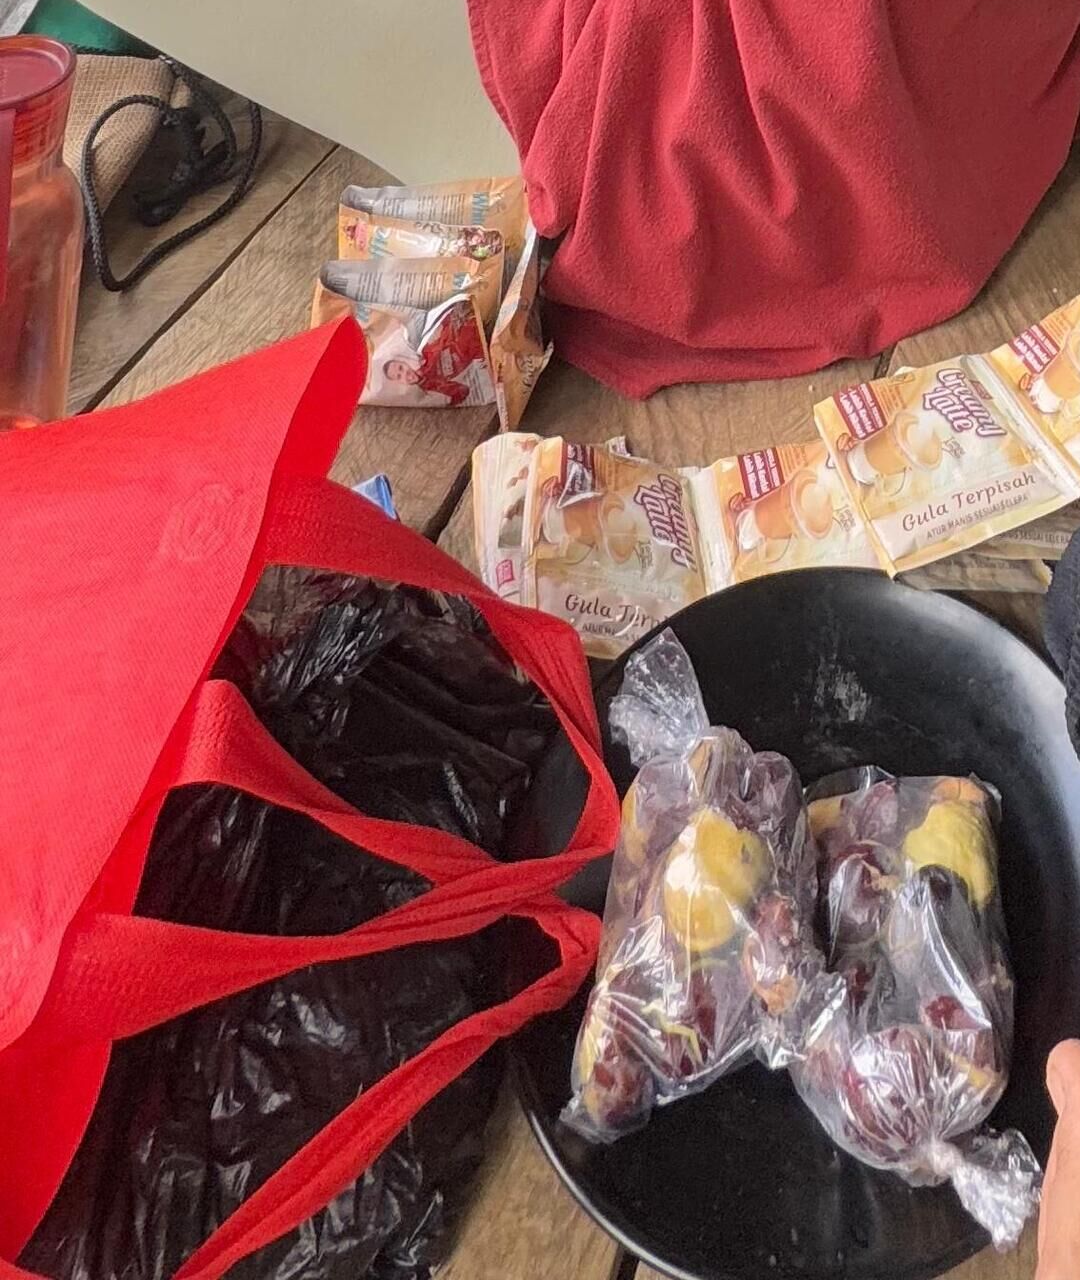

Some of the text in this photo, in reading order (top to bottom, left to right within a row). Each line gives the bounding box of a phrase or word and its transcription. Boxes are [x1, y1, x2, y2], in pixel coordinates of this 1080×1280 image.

[922, 386, 974, 433] Latte
[936, 367, 1008, 437] Creamy
[633, 484, 674, 544] Latte
[902, 503, 949, 532] Gula
[951, 471, 1037, 509] Terpisah
[565, 593, 612, 619] Gula
